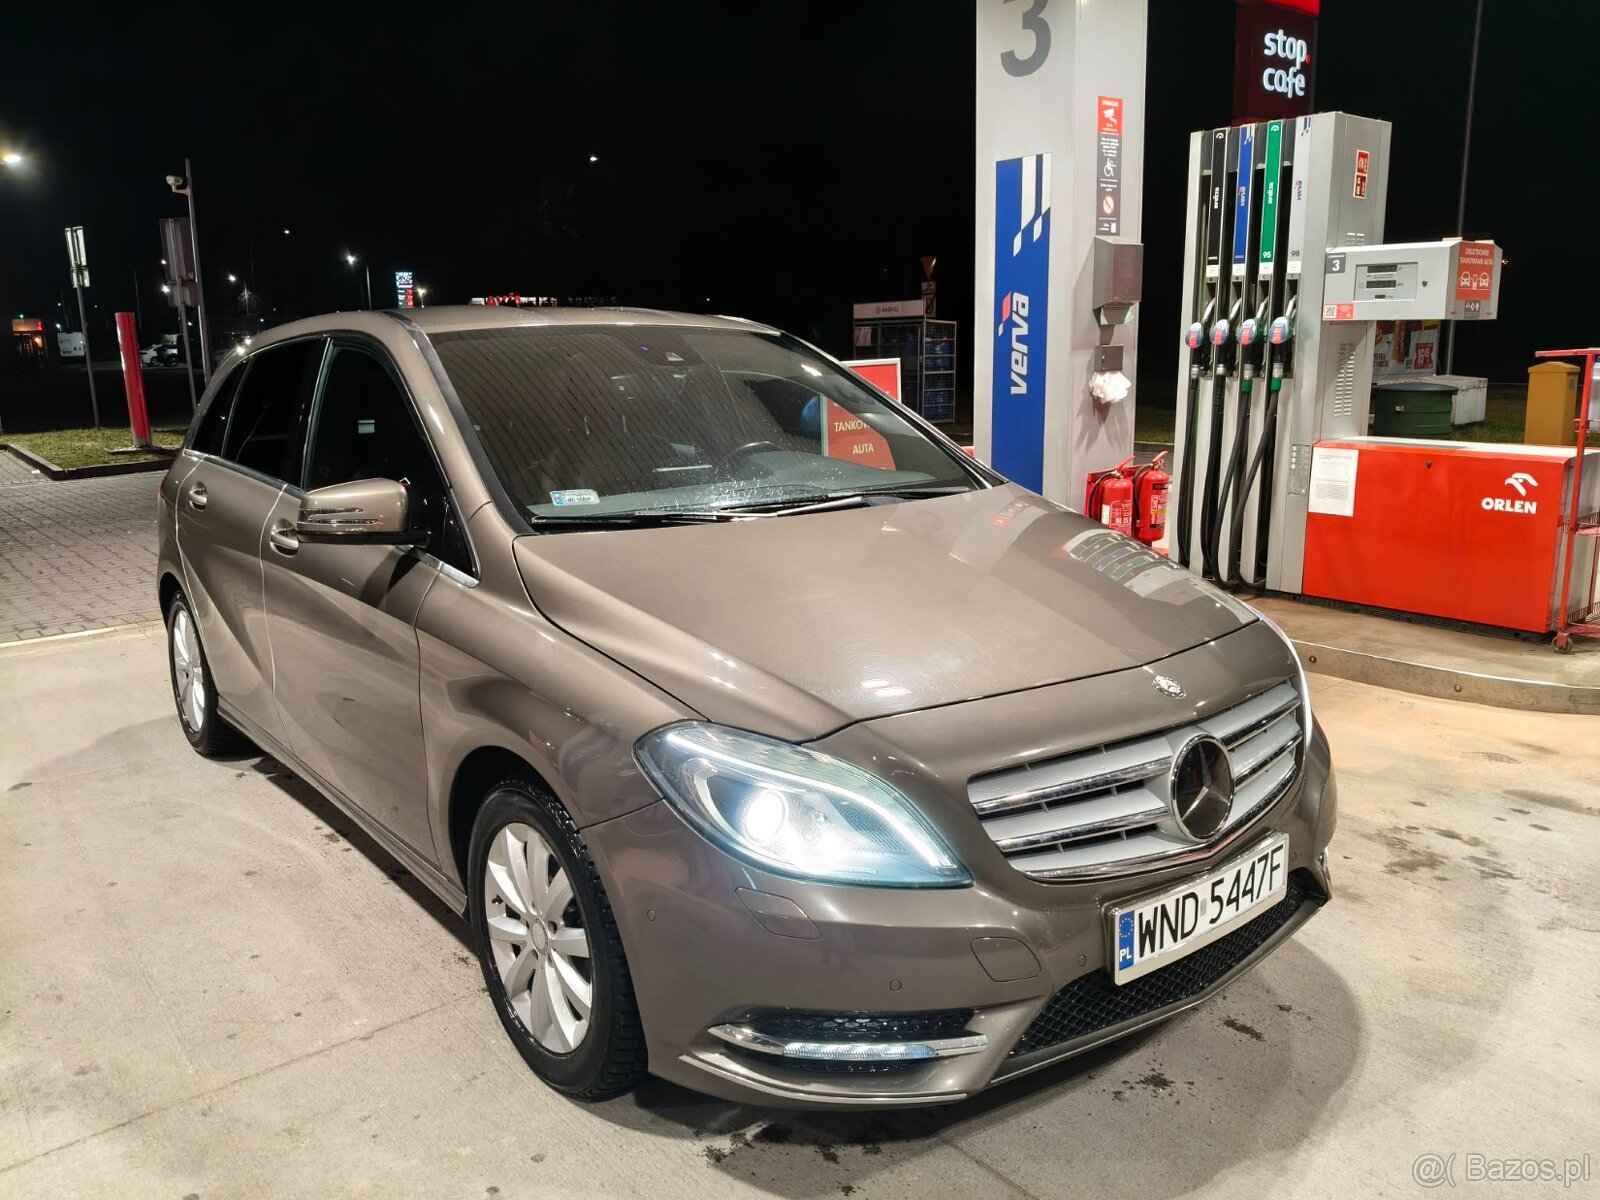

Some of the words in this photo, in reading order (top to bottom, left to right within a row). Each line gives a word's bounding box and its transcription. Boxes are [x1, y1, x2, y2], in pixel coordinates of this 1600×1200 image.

[1000, 0, 1051, 77] 3
[1263, 66, 1305, 98] cafe
[1262, 251, 1271, 259] 95
[1332, 260, 1340, 271] 3
[1010, 292, 1029, 394] verva
[852, 443, 874, 454] AUTA
[1481, 497, 1537, 514] ORLEN
[1138, 891, 1199, 958] WND
[1209, 844, 1284, 924] 5447F
[1119, 948, 1132, 962] PL
